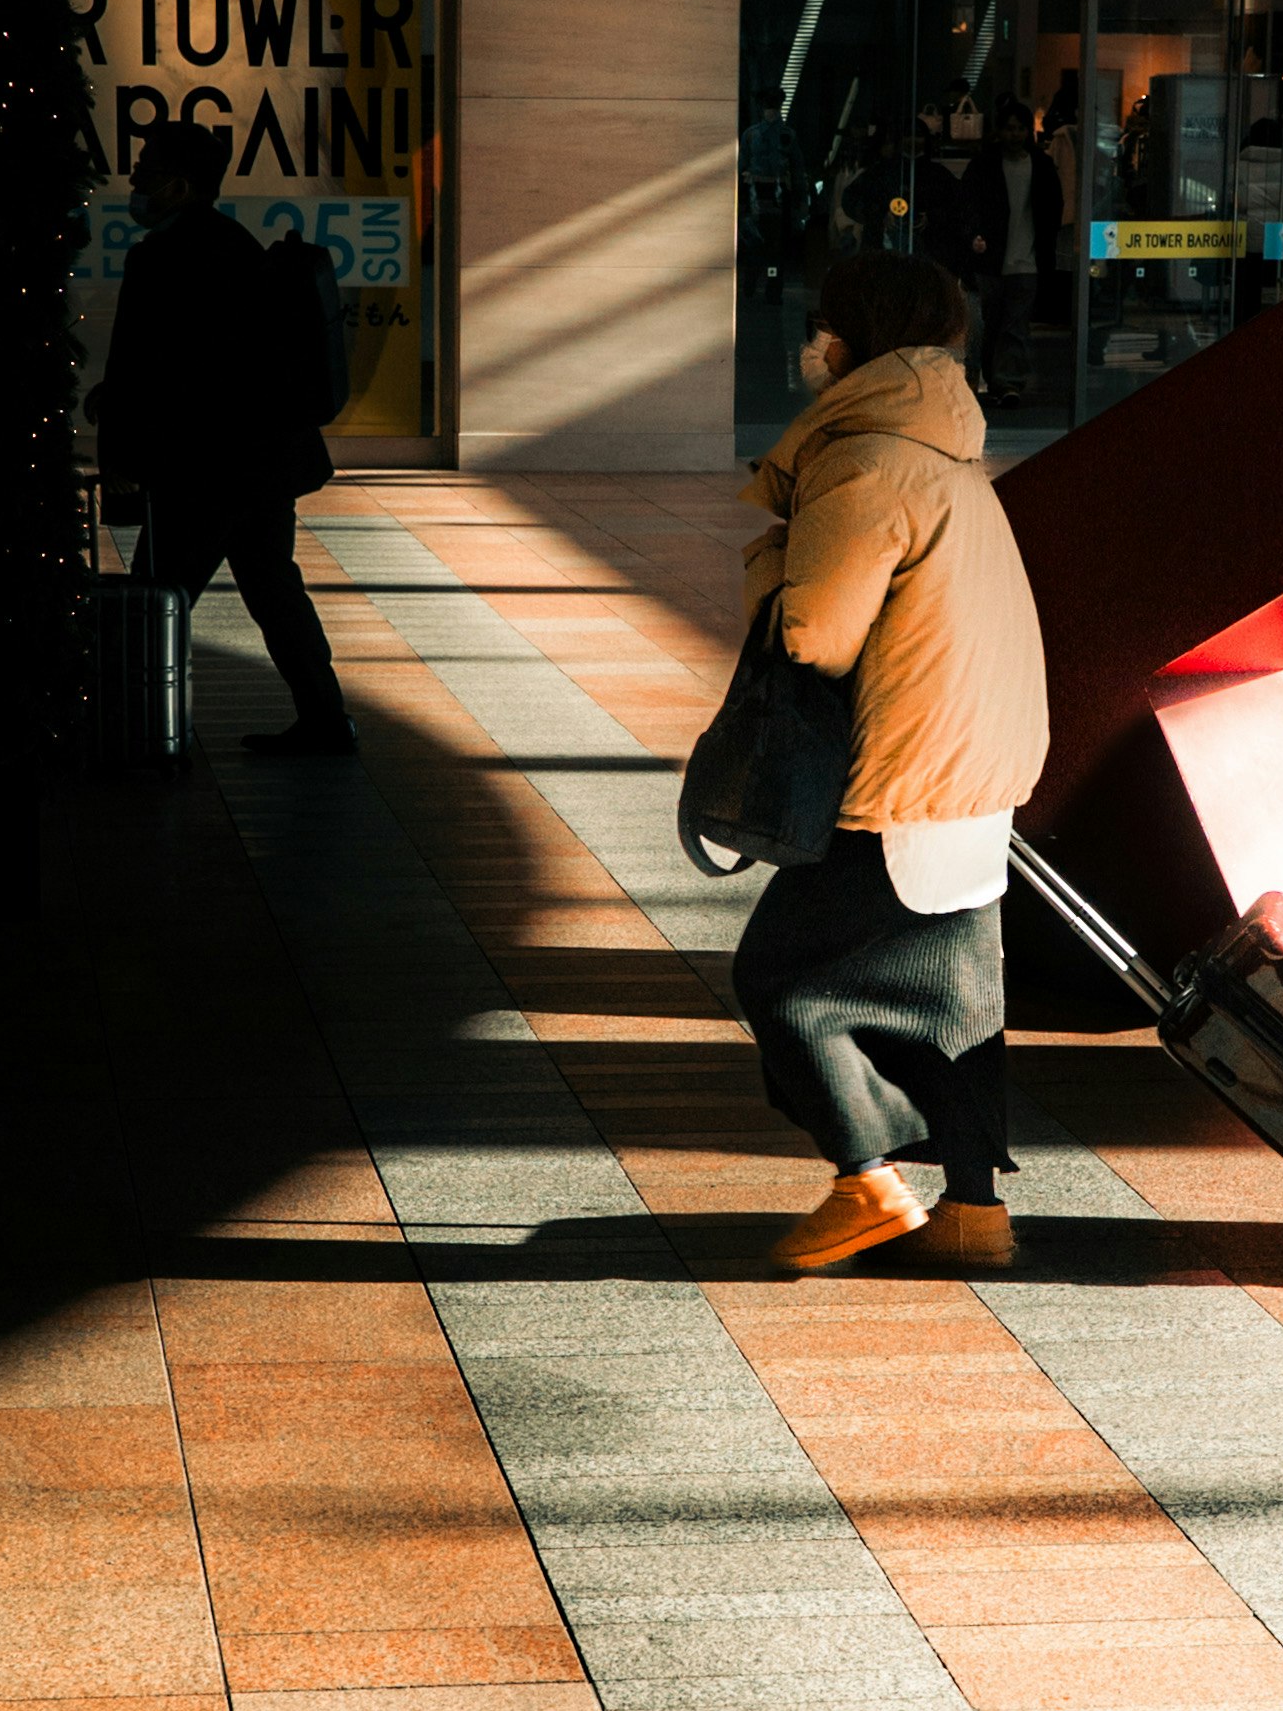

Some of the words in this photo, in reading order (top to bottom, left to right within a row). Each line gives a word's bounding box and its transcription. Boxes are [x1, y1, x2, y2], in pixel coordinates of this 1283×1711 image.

[362, 202, 401, 282] SUN
[1125, 233, 1142, 248] JR
[1145, 233, 1184, 249] TOWER
